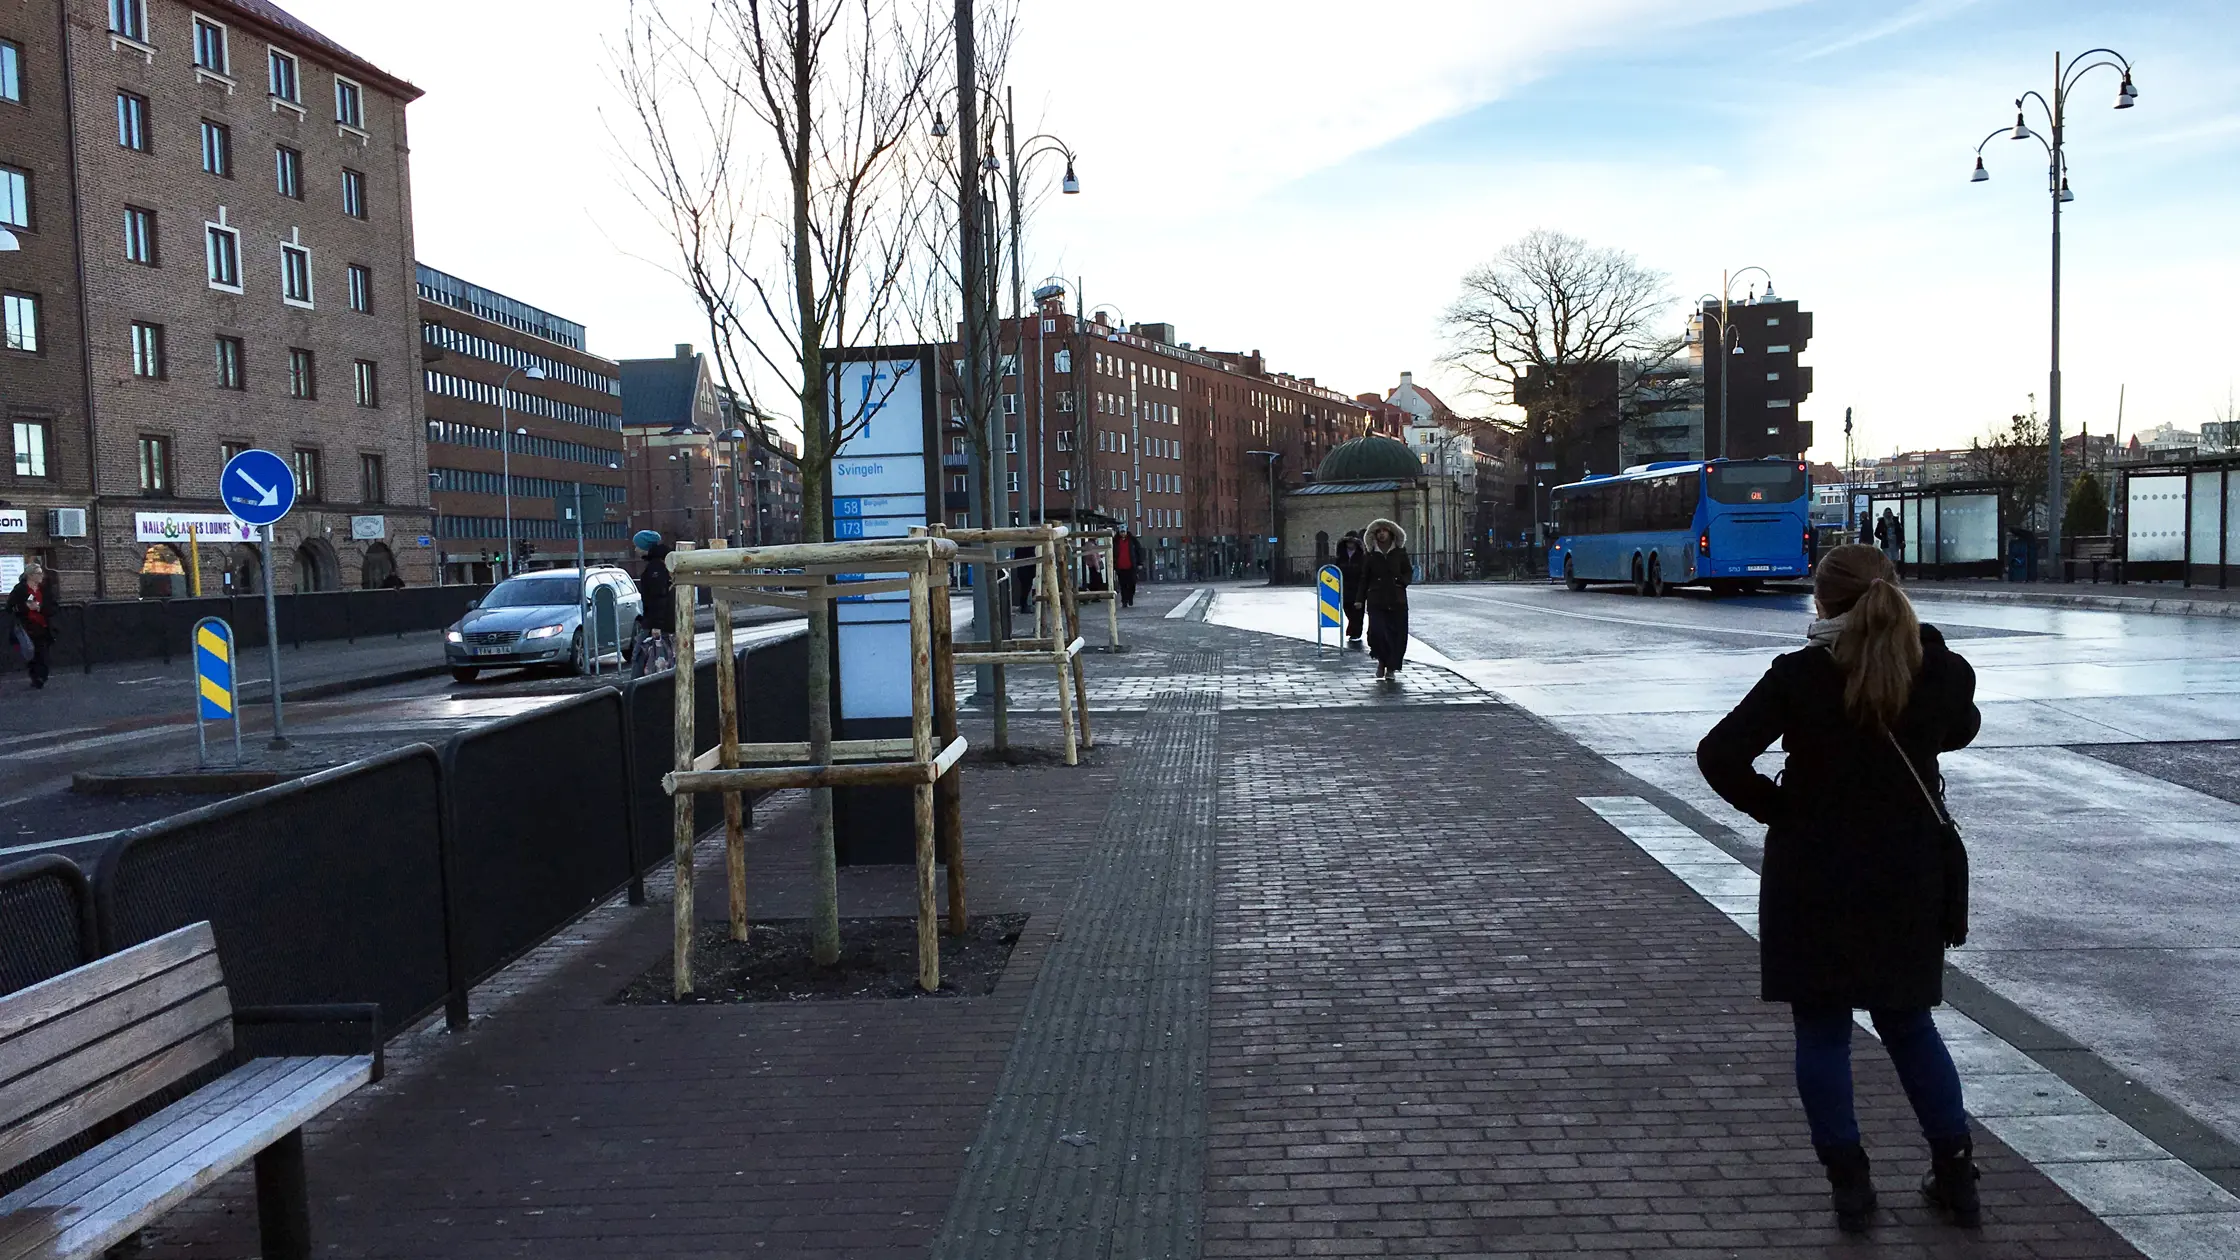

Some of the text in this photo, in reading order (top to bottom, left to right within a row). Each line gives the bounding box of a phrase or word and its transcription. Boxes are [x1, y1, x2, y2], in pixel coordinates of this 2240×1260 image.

[861, 374, 887, 438] F
[838, 463, 883, 477] Svingeln
[844, 501, 858, 514] 58
[0, 518, 23, 527] om
[142, 521, 165, 534] NAILS
[205, 522, 231, 535] LOUNGE
[842, 522, 861, 535] 173
